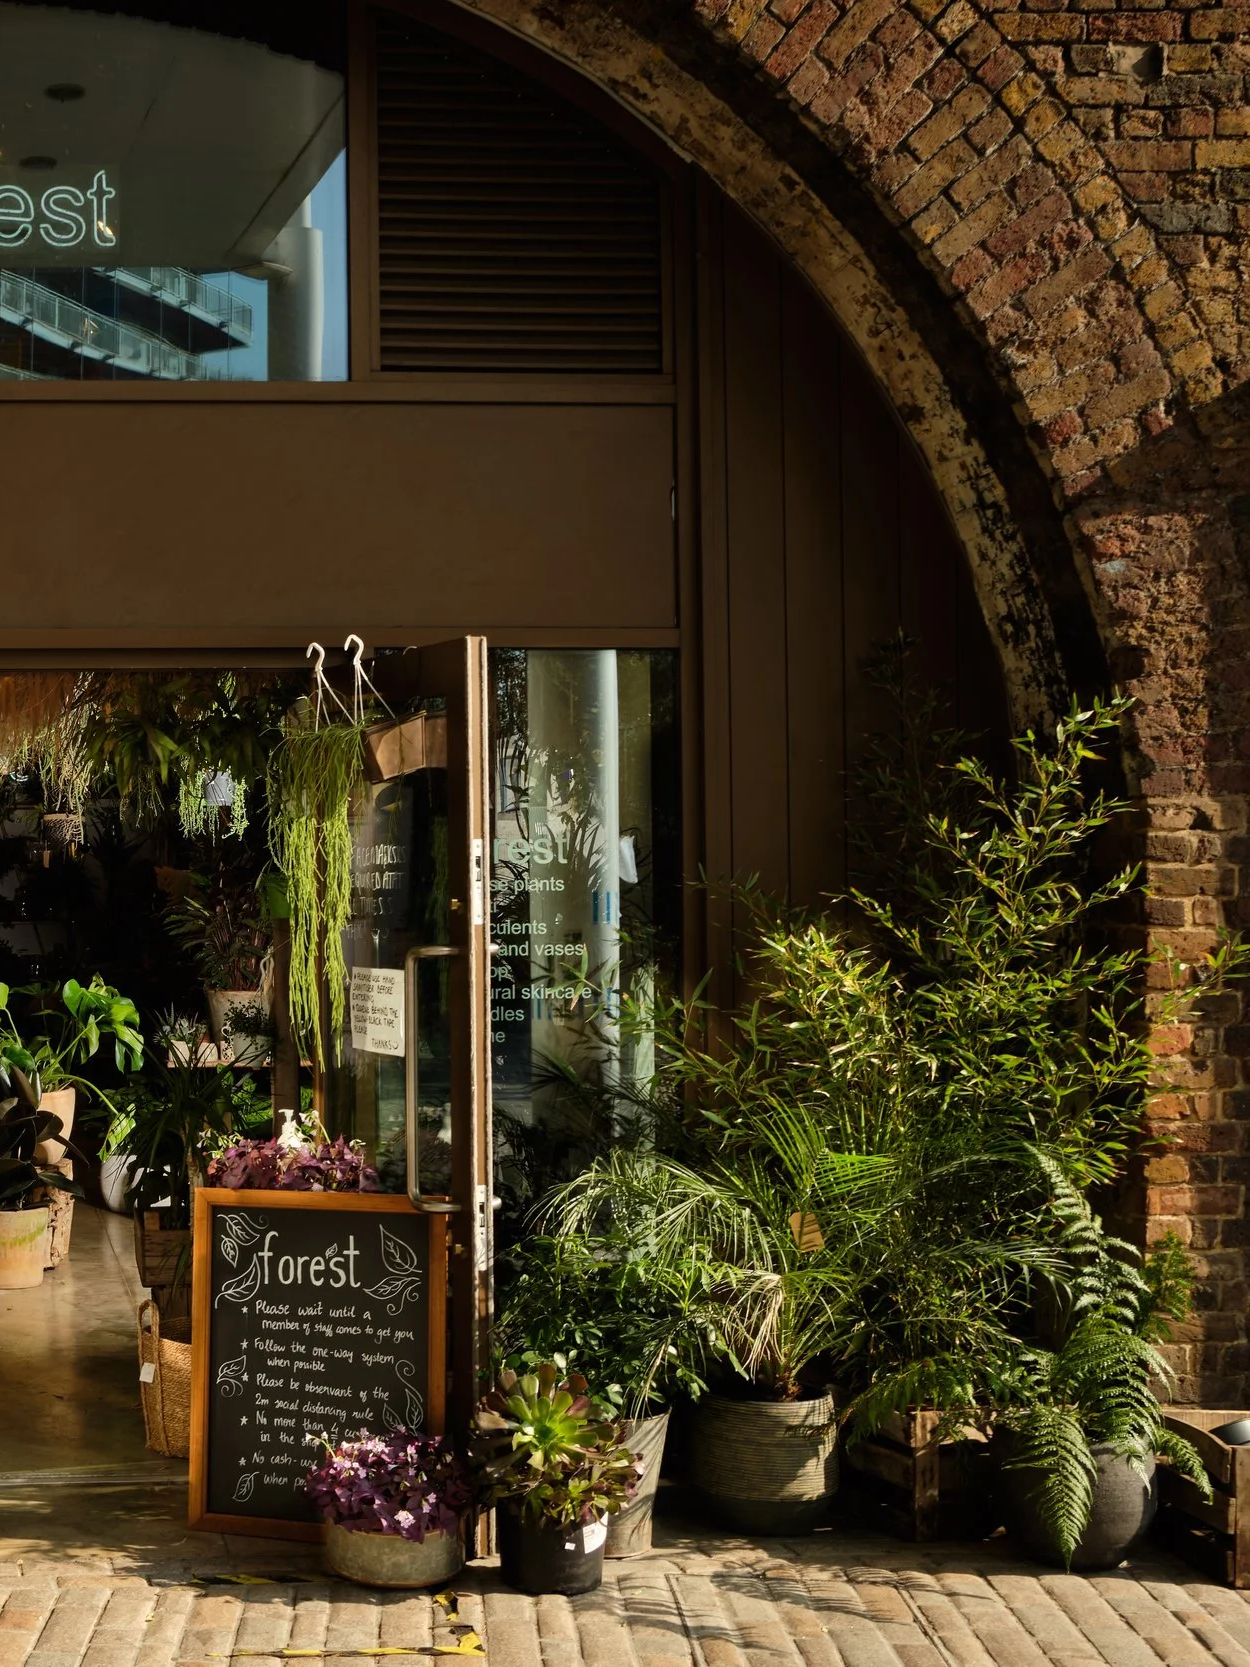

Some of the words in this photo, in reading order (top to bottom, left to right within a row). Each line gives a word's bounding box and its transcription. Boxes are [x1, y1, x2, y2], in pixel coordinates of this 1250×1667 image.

[494, 833, 568, 865] rest
[514, 876, 565, 895] plants
[490, 920, 547, 935] culents
[498, 941, 529, 956] and
[534, 943, 584, 956] vases
[521, 984, 592, 1000] skincae
[491, 1006, 525, 1021] dles
[372, 1038, 391, 1050] THANKS
[258, 1230, 361, 1288] forest
[255, 1300, 290, 1315] Please
[298, 1301, 323, 1316] wait
[329, 1306, 356, 1318] until
[363, 1311, 372, 1321] a
[262, 1319, 300, 1331] member
[303, 1322, 310, 1336] of
[313, 1322, 333, 1337] staff
[335, 1325, 362, 1335] comes
[364, 1325, 374, 1335] to
[374, 1327, 391, 1344] get
[393, 1329, 414, 1344] you
[254, 1337, 286, 1352] Follow
[290, 1341, 306, 1354] the
[312, 1346, 354, 1364] one-way
[361, 1352, 395, 1367] system
[267, 1357, 290, 1367] when
[293, 1360, 326, 1373] possible
[256, 1373, 284, 1387] Please
[290, 1378, 300, 1391] be
[304, 1381, 353, 1398] observant
[359, 1389, 368, 1403] of
[372, 1386, 390, 1401] the
[255, 1393, 269, 1406] 2m
[274, 1399, 300, 1411] social
[302, 1401, 347, 1423] distancing
[352, 1408, 375, 1421] rule
[255, 1411, 267, 1425] No
[274, 1416, 296, 1428] more
[302, 1418, 324, 1431] than
[330, 1423, 339, 1435] 4
[260, 1431, 271, 1442] in
[280, 1432, 295, 1445] the
[252, 1452, 265, 1465] No
[263, 1472, 289, 1486] when
